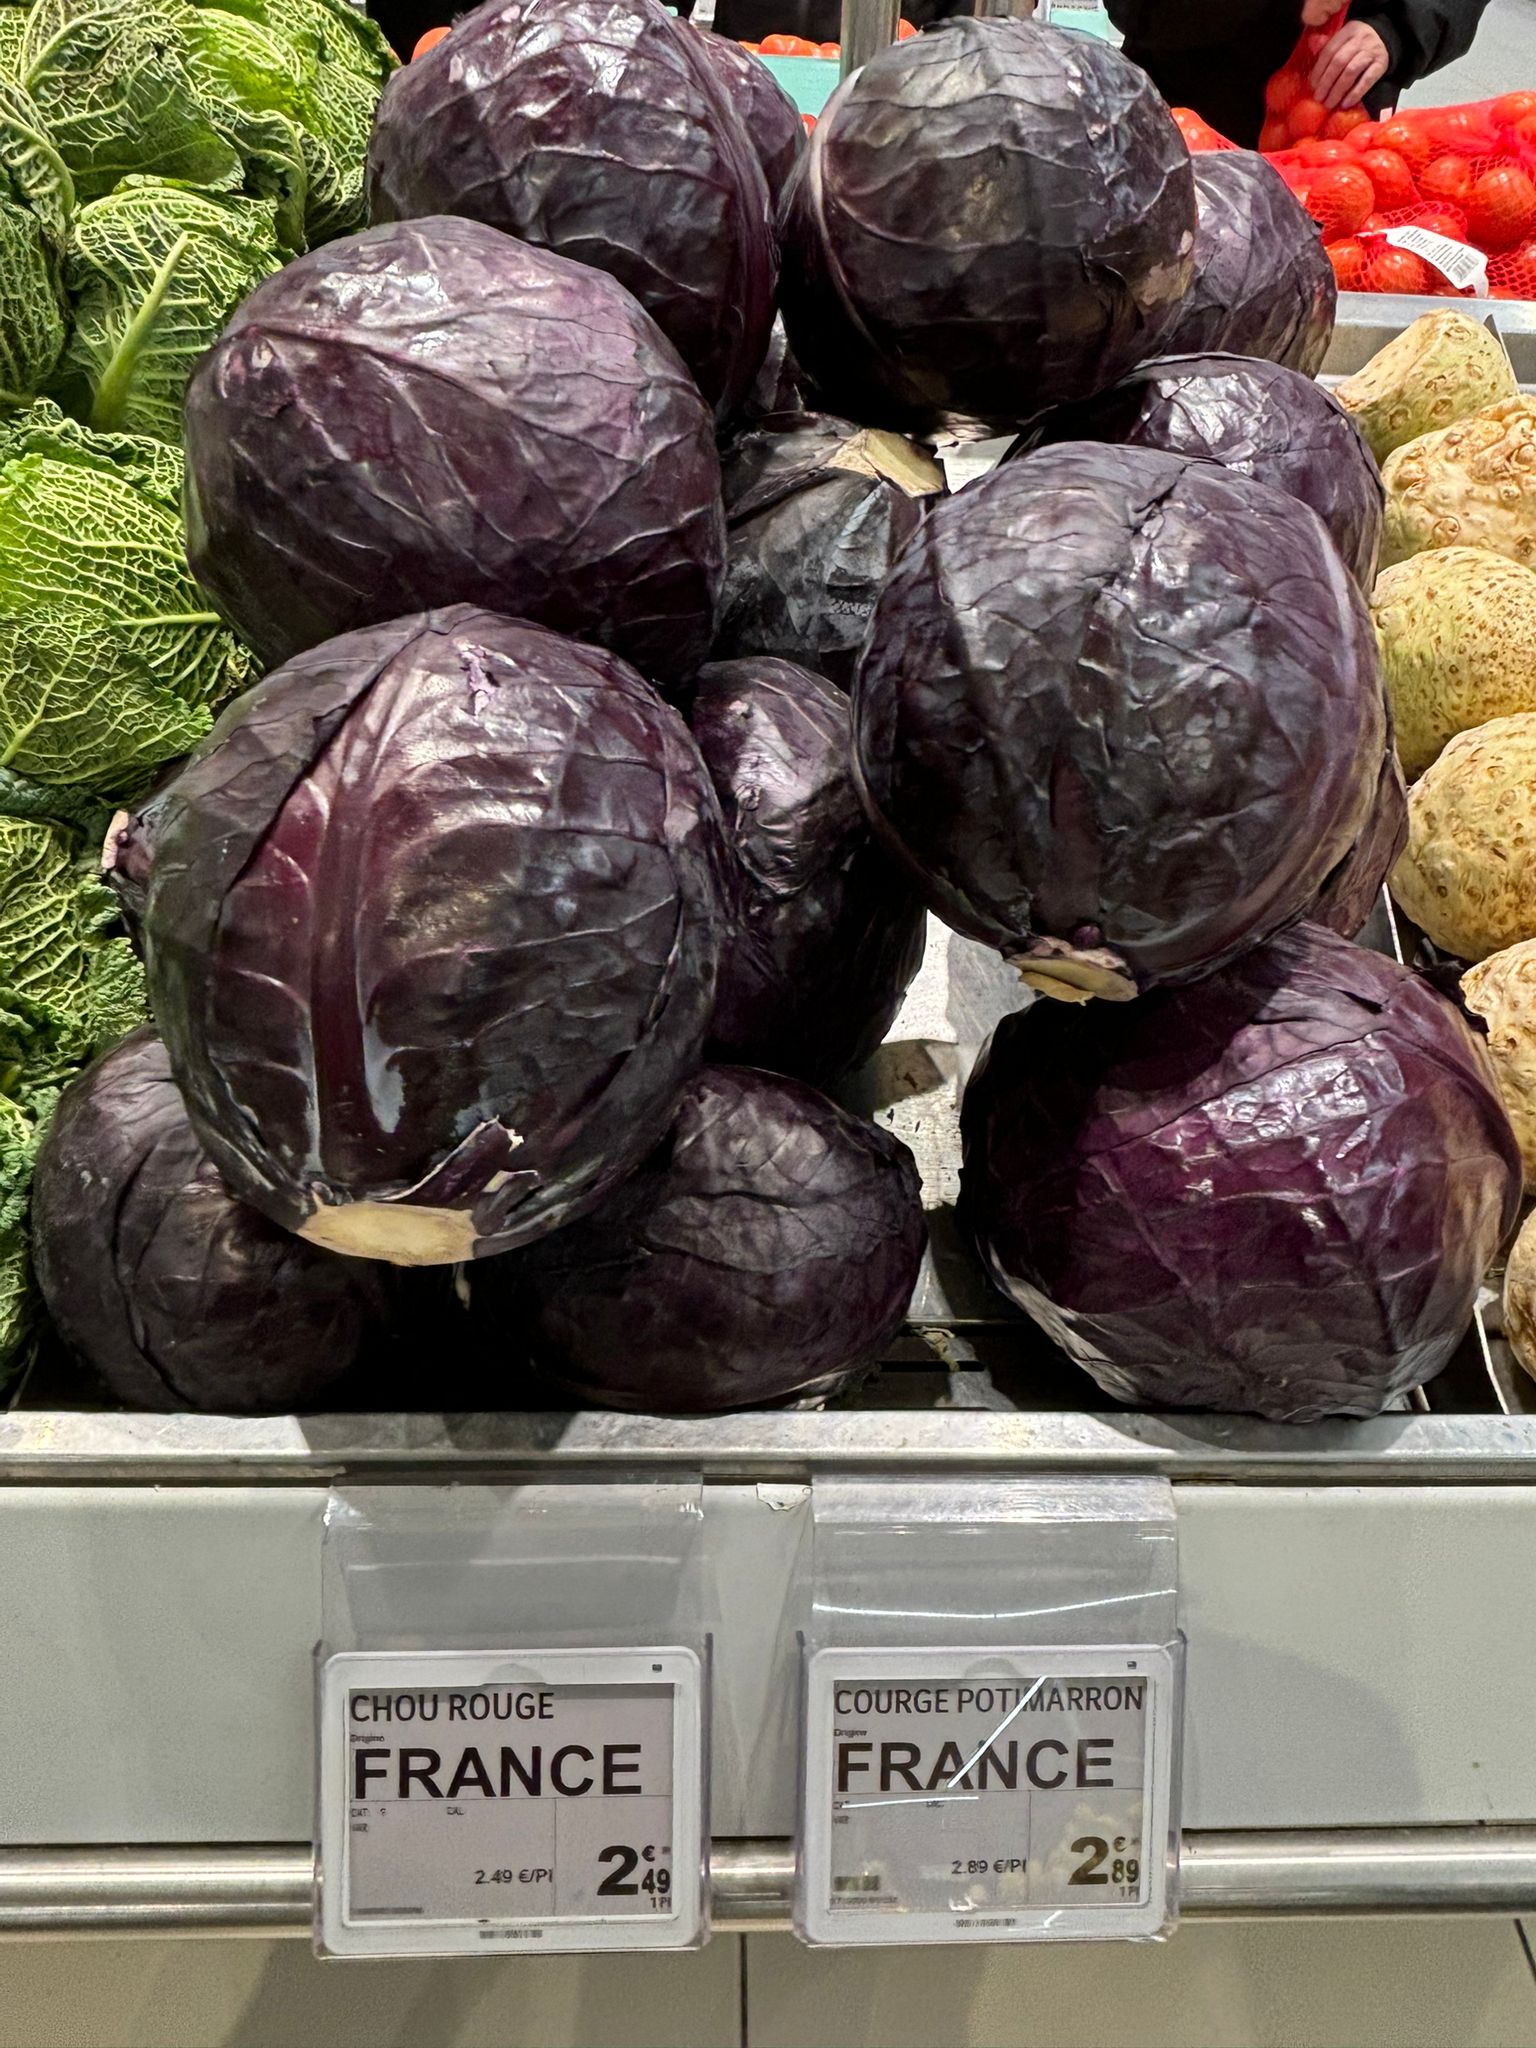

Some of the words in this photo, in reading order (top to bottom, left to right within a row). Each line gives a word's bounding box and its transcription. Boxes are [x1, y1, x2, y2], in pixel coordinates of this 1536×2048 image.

[350, 1693, 438, 1723] CHOU
[448, 1692, 555, 1721] ROUGE
[834, 1689, 950, 1715] COURGE
[957, 1685, 1143, 1714] POTIMARRON
[354, 1743, 642, 1800] FRANCE
[837, 1738, 1115, 1793] FRANCE
[474, 1869, 513, 1885] 2.49
[596, 1844, 639, 1896] 2
[641, 1868, 671, 1894] 49
[951, 1859, 988, 1875] 2.89
[1067, 1836, 1109, 1886] 2
[1112, 1859, 1140, 1884] 89
